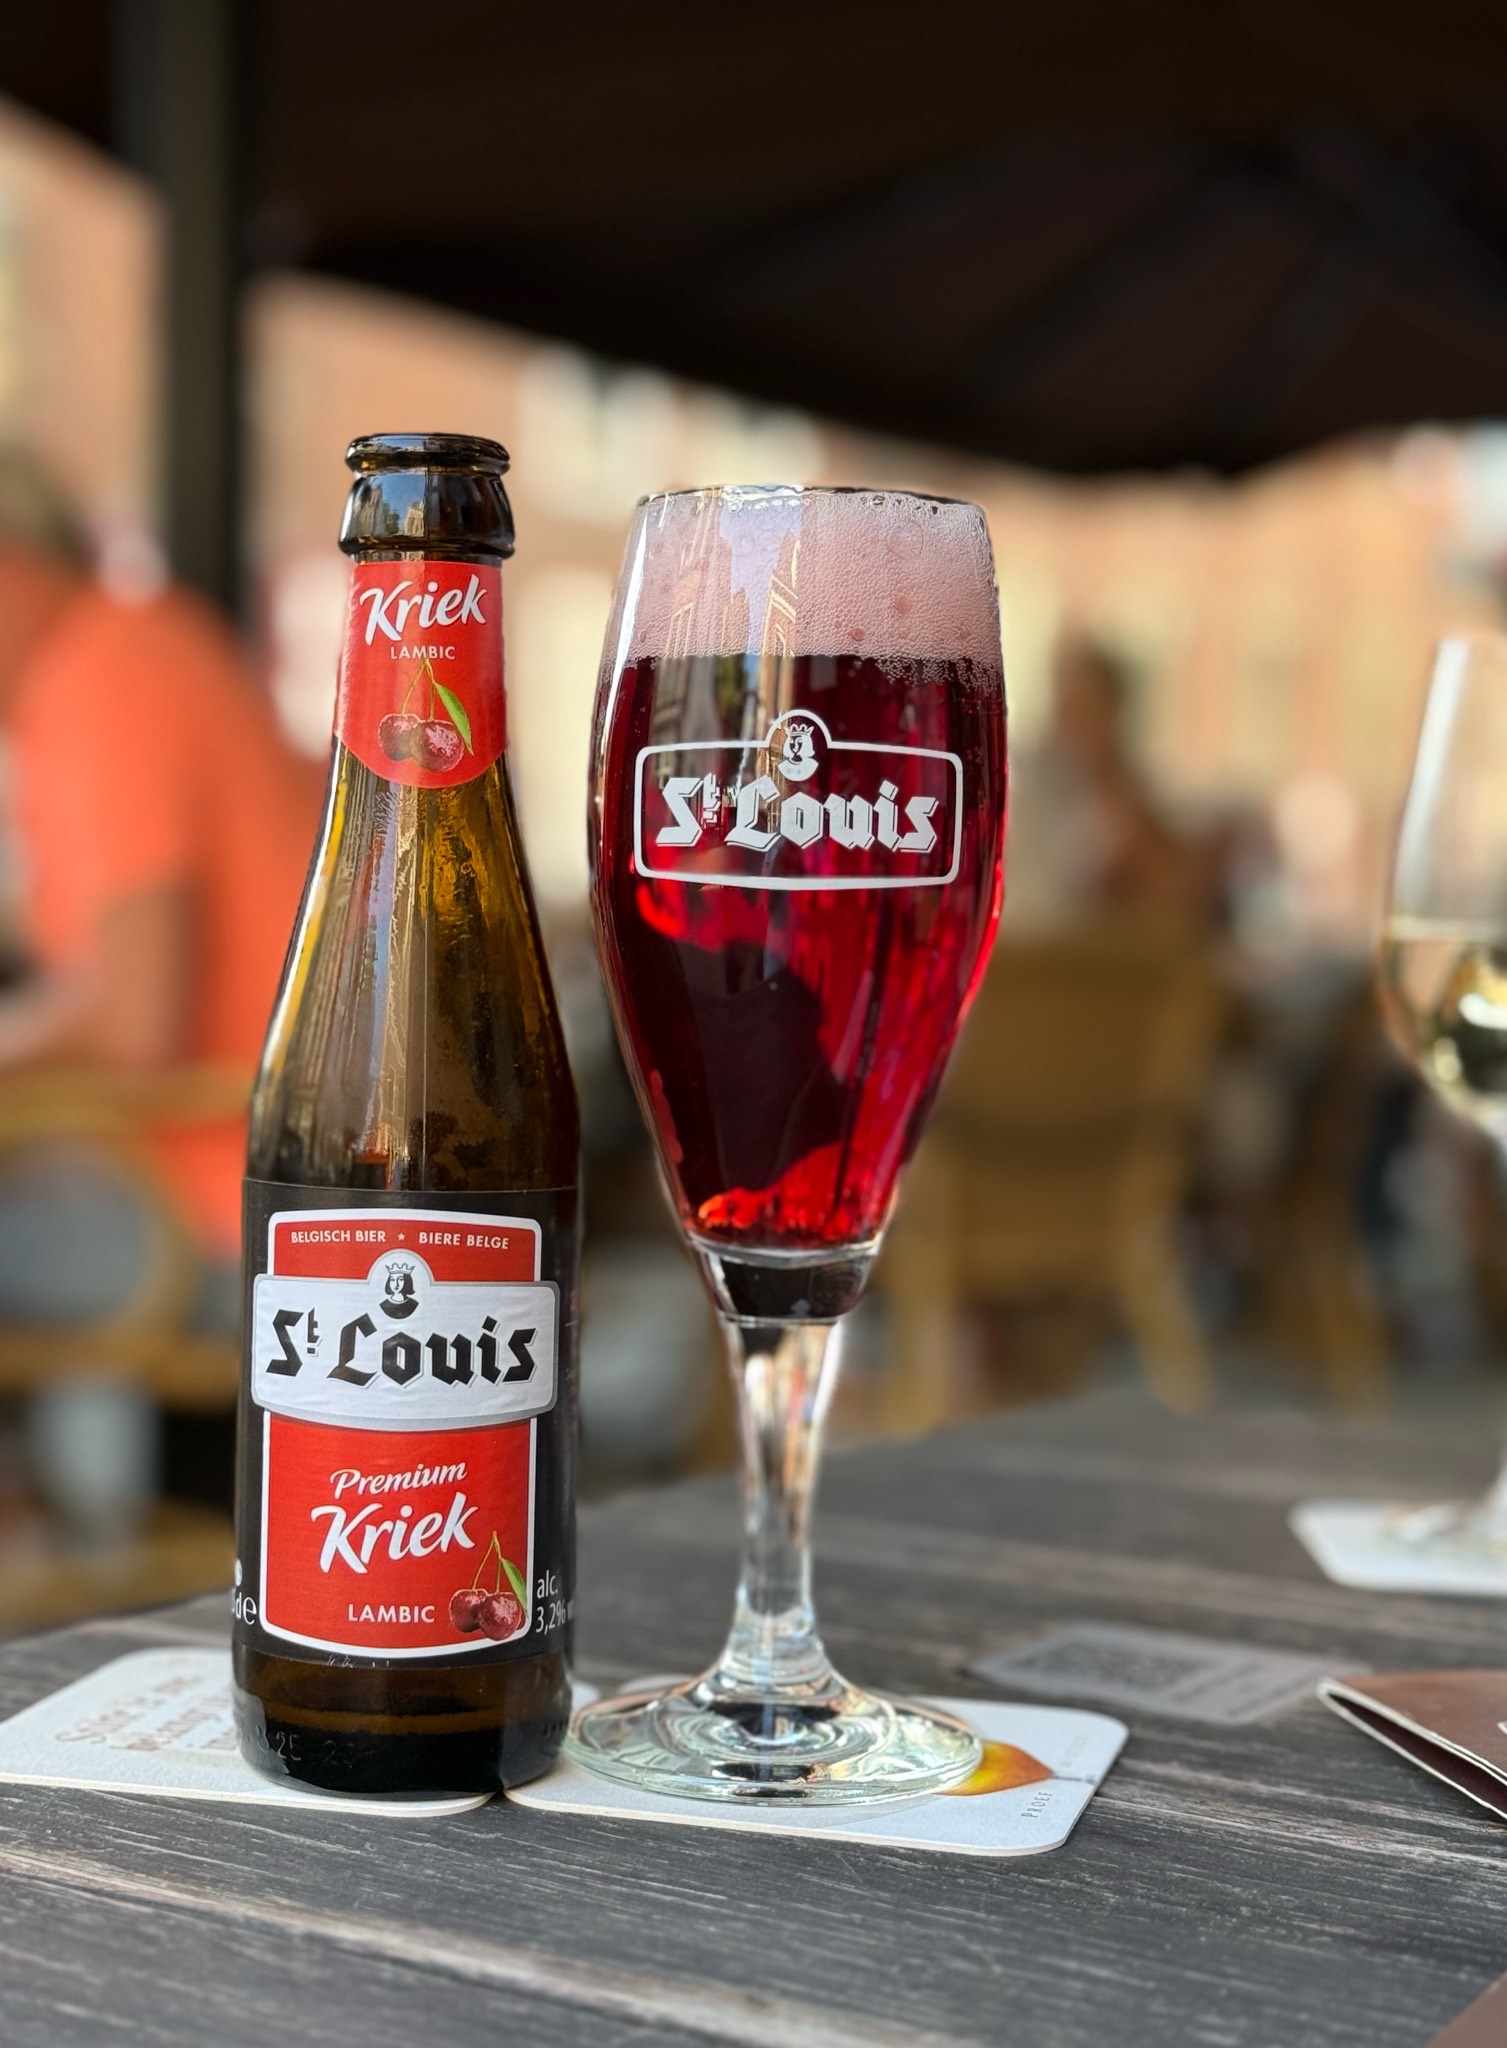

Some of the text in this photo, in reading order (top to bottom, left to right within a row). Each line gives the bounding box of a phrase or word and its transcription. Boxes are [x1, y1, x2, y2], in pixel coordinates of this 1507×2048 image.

[360, 574, 487, 645] Kriek
[390, 646, 456, 660] LAMBIC
[724, 775, 939, 853] Louis
[290, 1230, 510, 1250] BELGISCH BIER BIERE BELGE
[326, 1313, 537, 1387] Louis
[329, 1462, 468, 1499] Premium
[311, 1492, 478, 1574] Kriek
[536, 1569, 559, 1599] alc.
[348, 1604, 436, 1624] LAMBIC
[535, 1598, 567, 1635] 3,2%
[1020, 1791, 1053, 1819] PROEF
